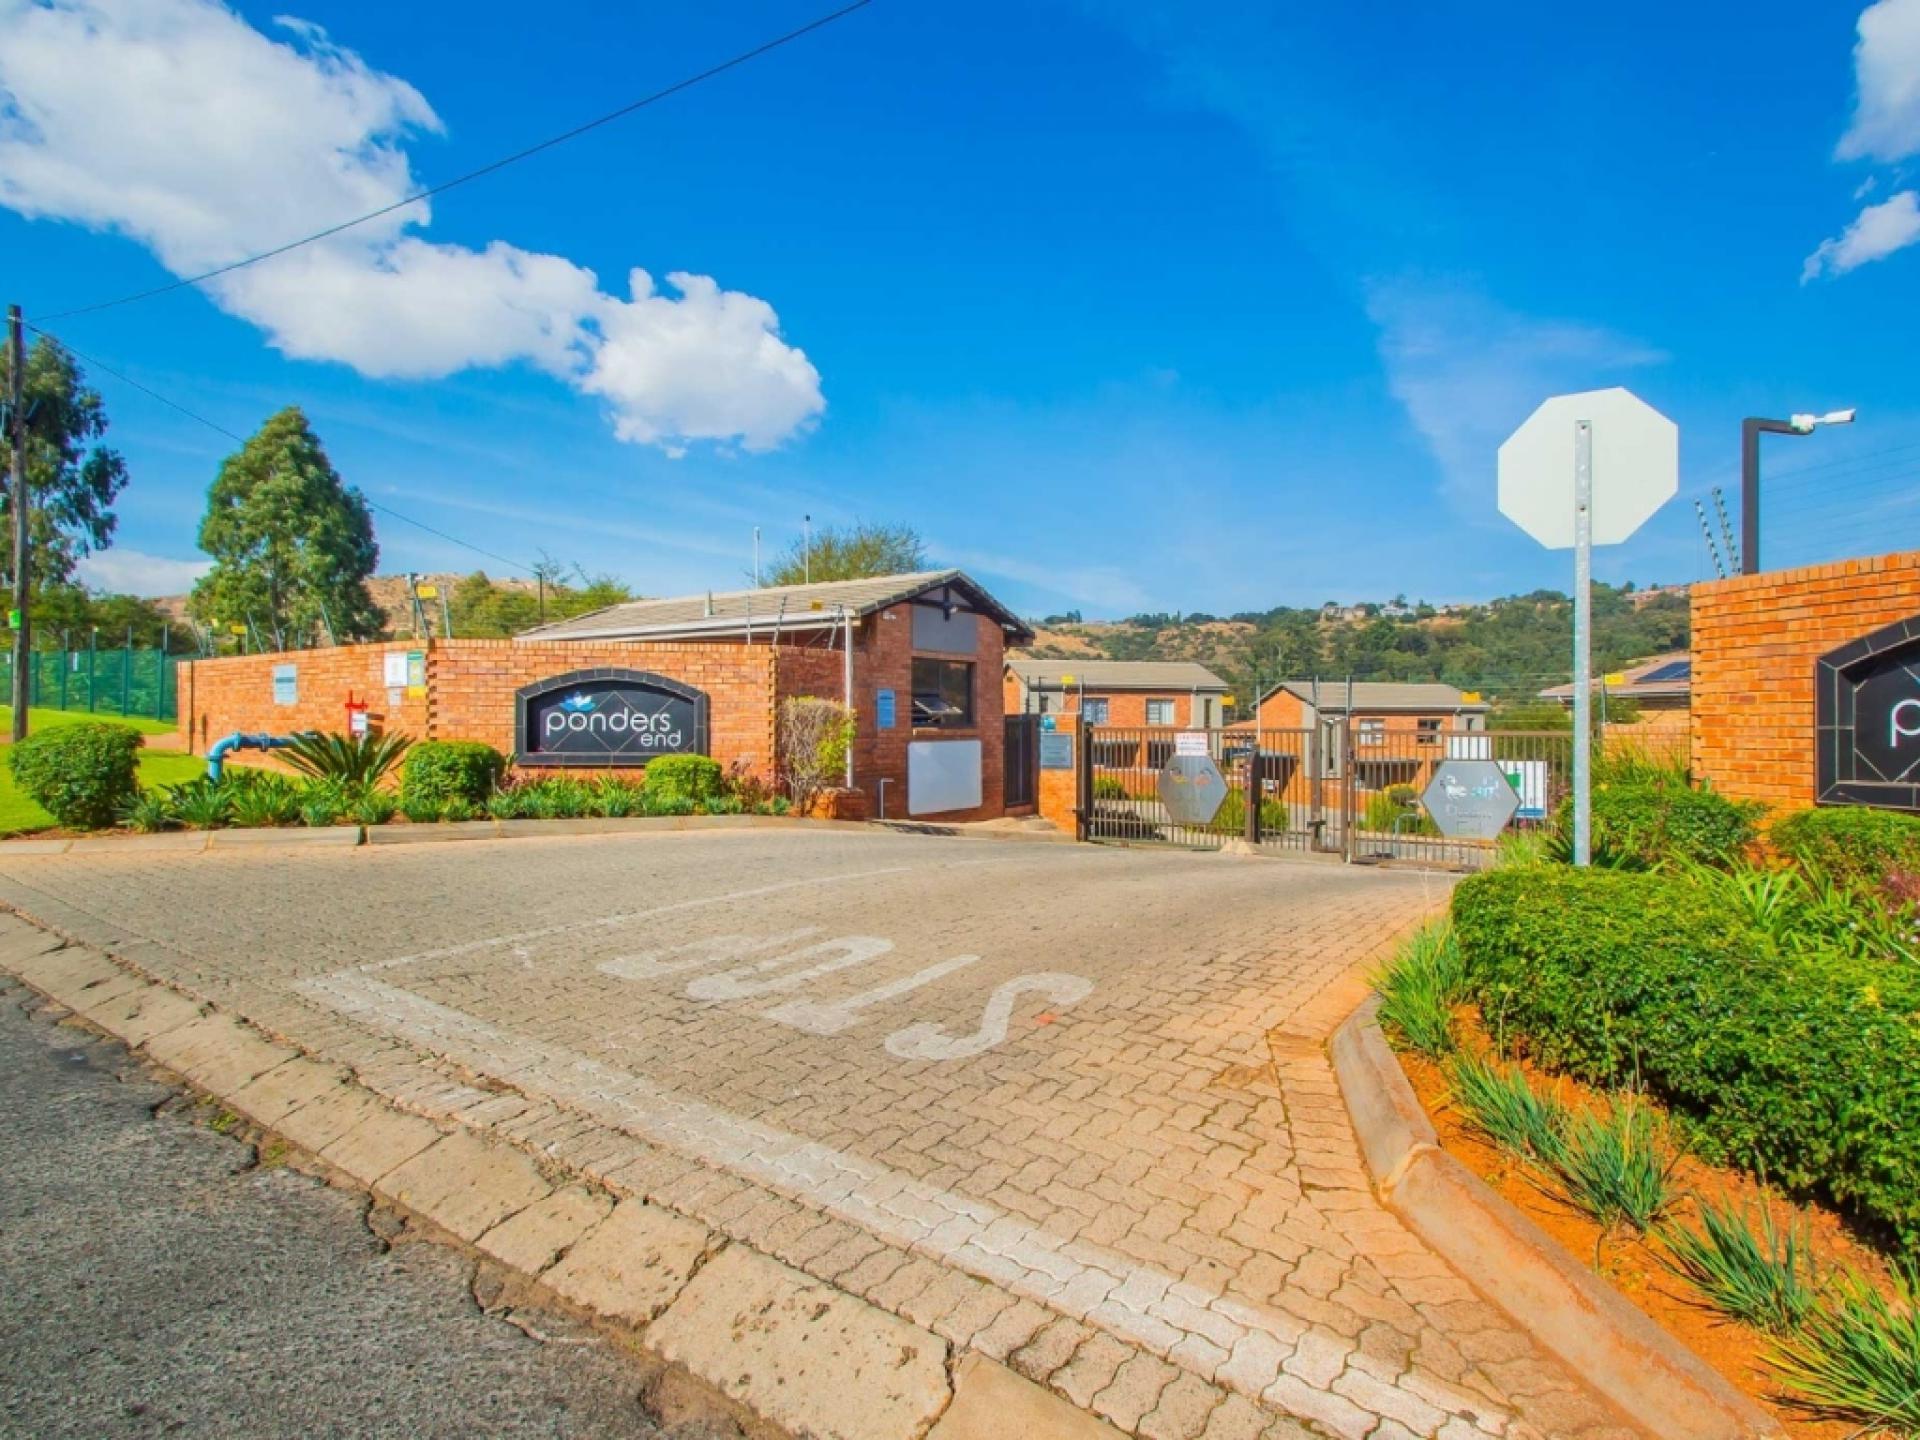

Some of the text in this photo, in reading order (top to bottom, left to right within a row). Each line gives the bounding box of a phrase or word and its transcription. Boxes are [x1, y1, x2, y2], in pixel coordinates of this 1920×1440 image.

[545, 707, 671, 736] ponders
[640, 730, 682, 747] end
[596, 926, 1094, 1060] STOP
